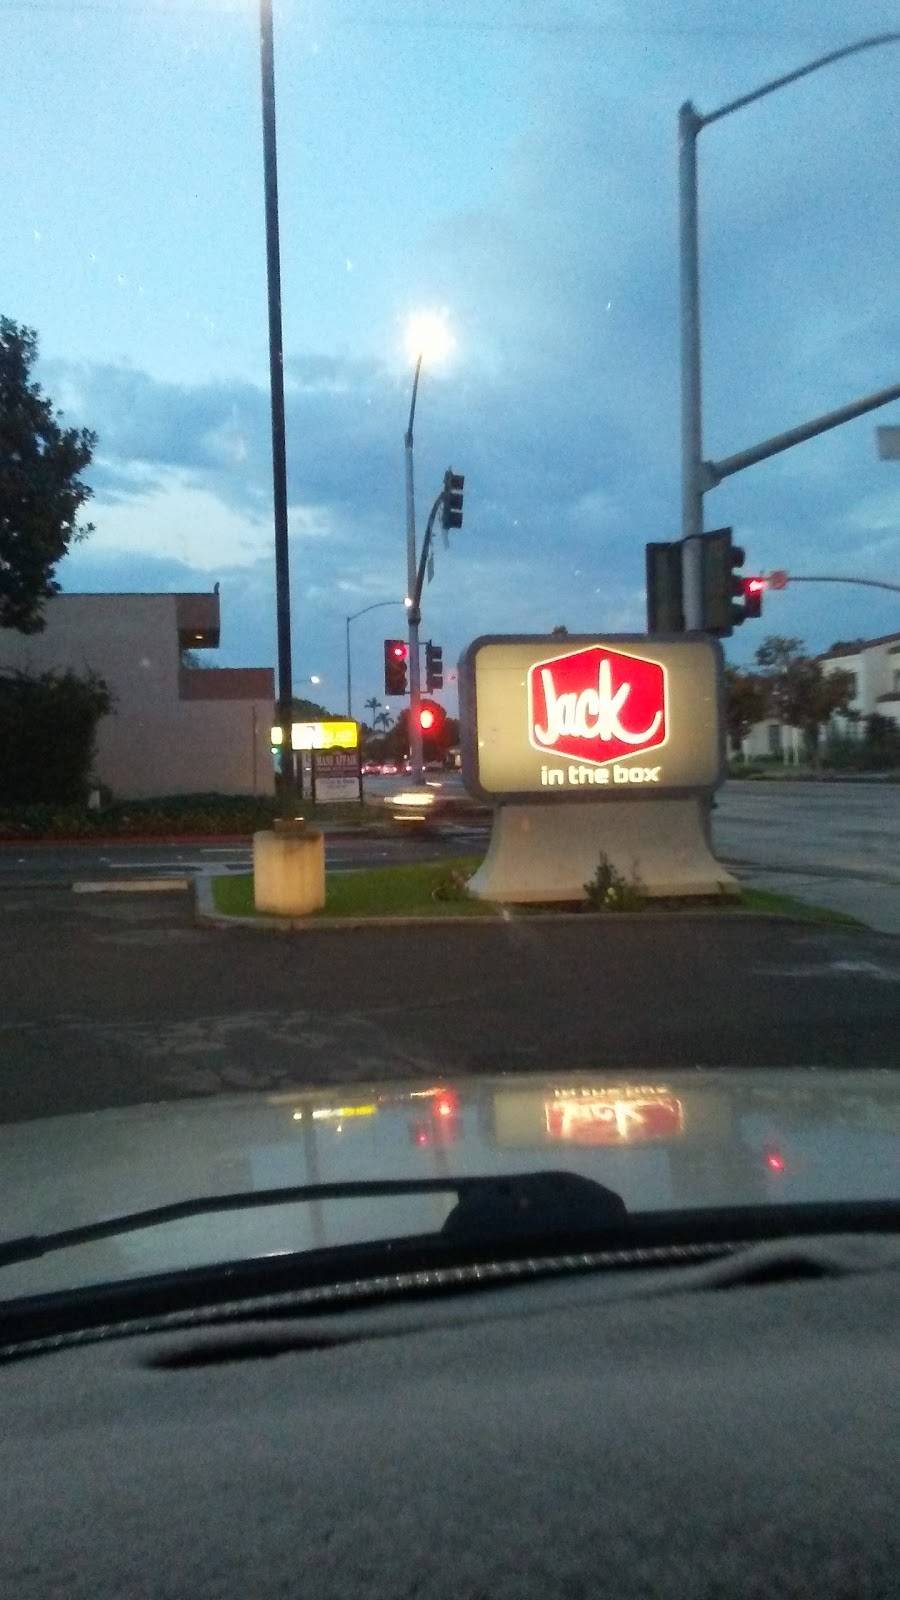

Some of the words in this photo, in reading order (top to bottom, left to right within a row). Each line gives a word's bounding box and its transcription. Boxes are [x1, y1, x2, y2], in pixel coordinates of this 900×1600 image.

[535, 659, 662, 744] Jack
[541, 766, 563, 785] in
[568, 766, 609, 784] the
[613, 765, 661, 784] box
